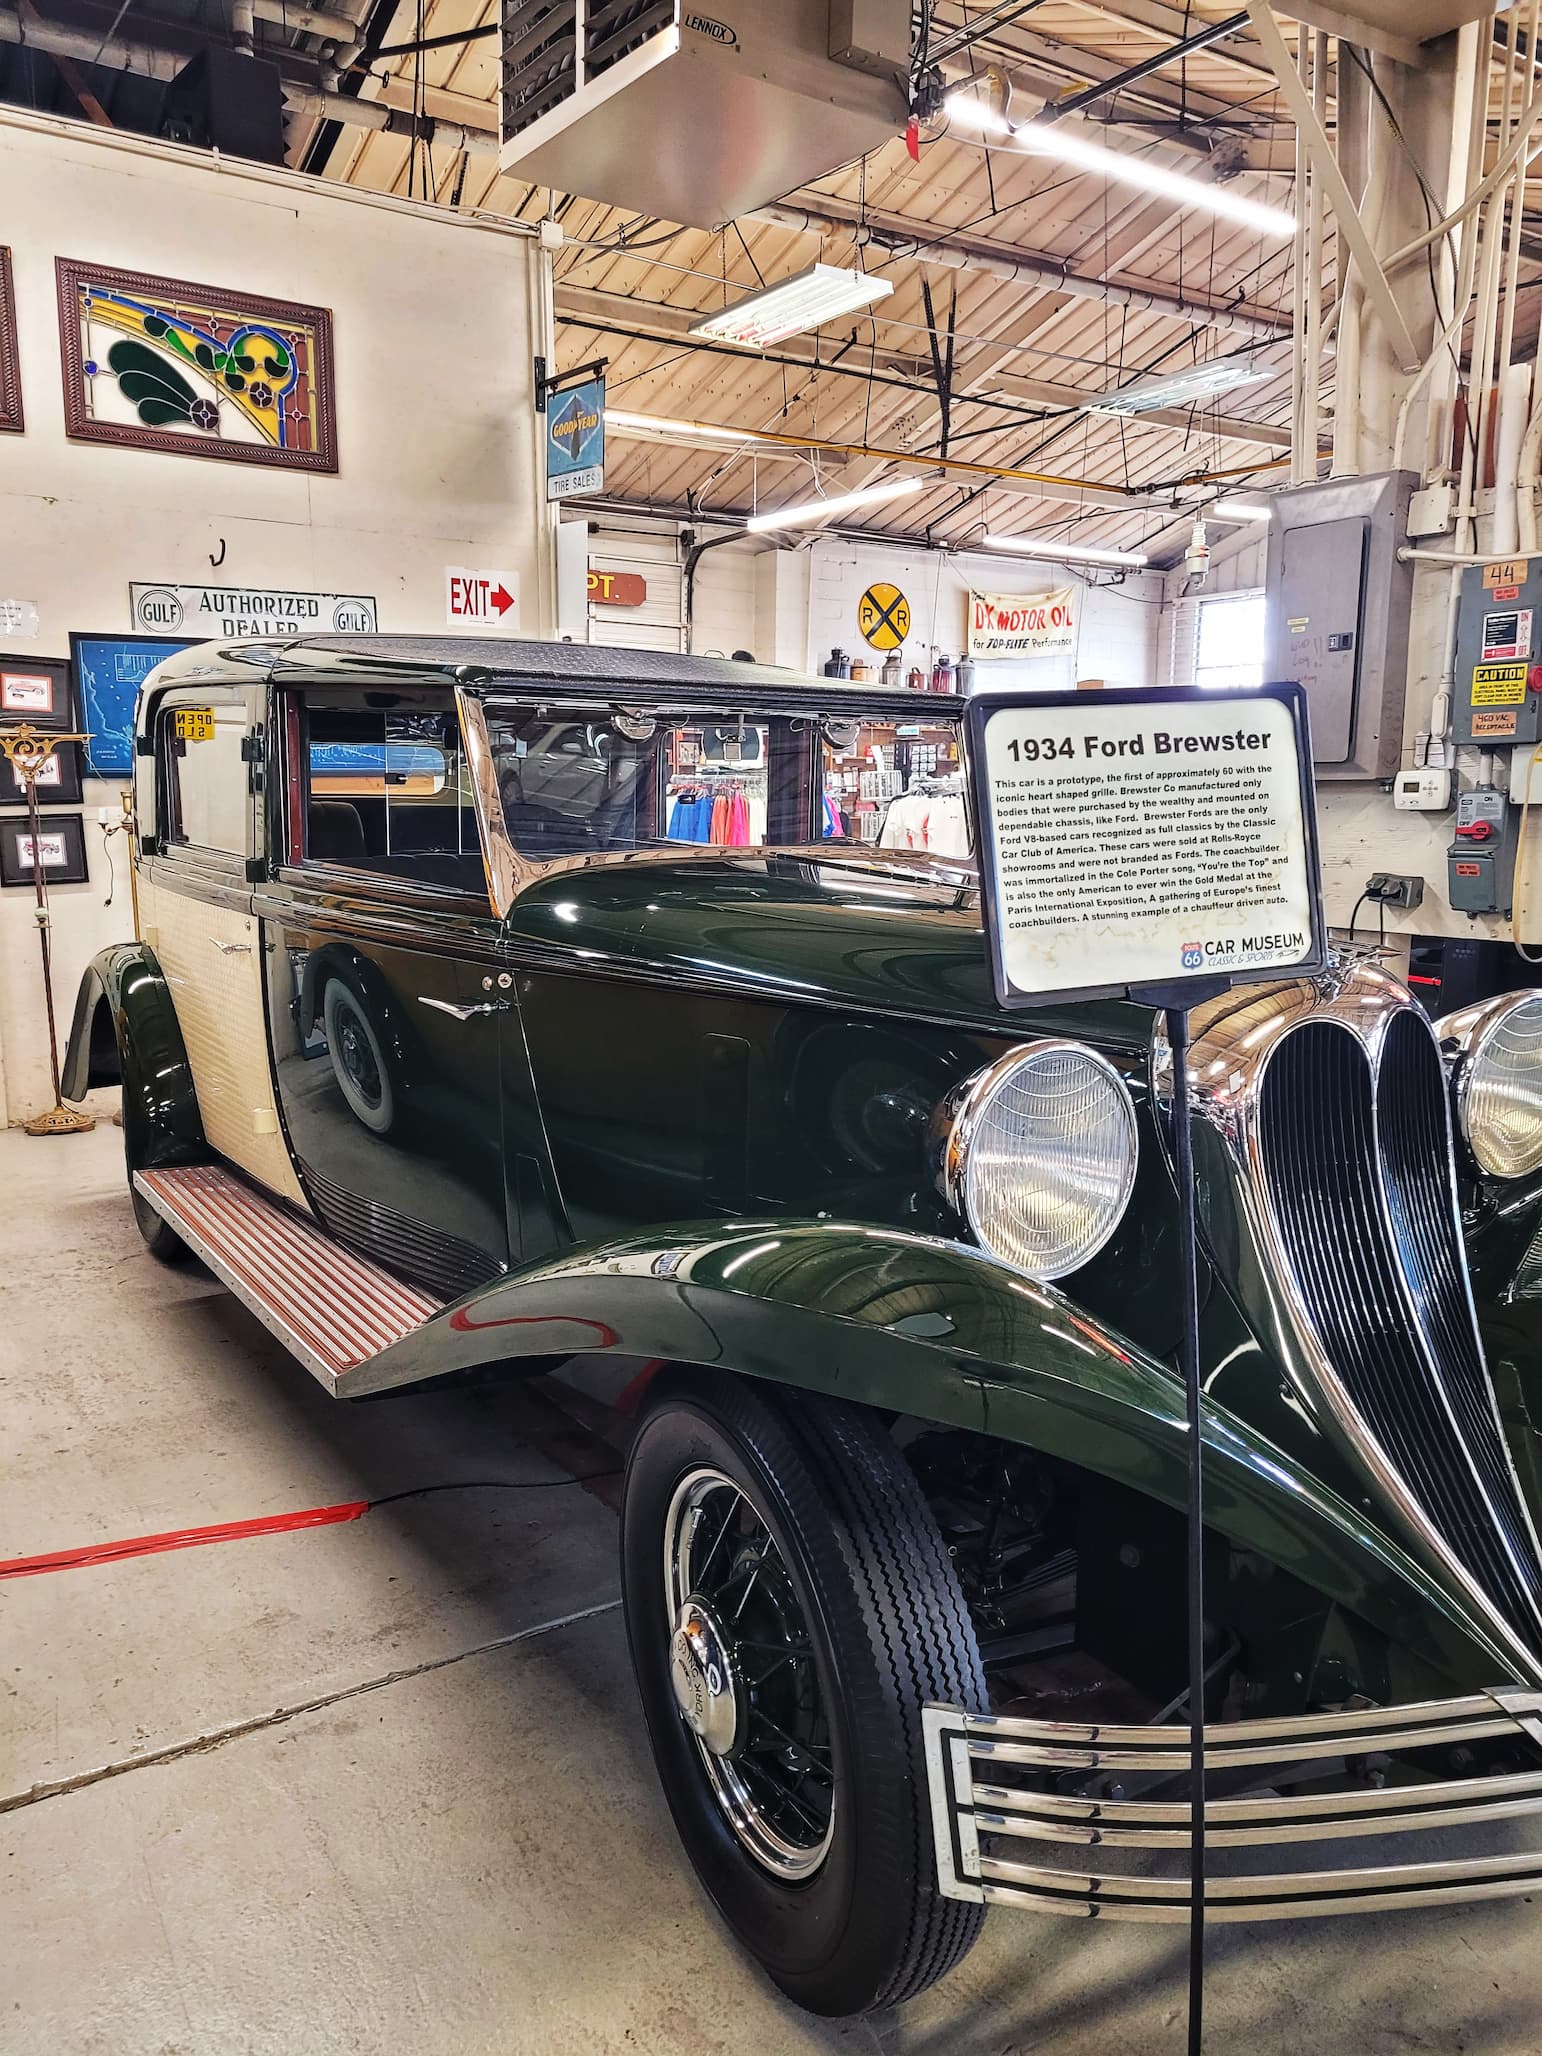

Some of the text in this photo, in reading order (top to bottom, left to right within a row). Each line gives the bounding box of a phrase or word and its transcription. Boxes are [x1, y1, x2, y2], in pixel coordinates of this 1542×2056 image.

[685, 14, 727, 40] LENNOX
[553, 472, 596, 494] TIRE SALES
[1490, 565, 1514, 584] 44
[199, 591, 320, 618] AUTHORIZED
[450, 577, 490, 616] EXIT
[142, 603, 178, 624] GULF
[337, 612, 368, 632] GULF
[862, 607, 908, 626] R R
[997, 608, 1046, 632] MOTOR
[1050, 605, 1073, 627] OIL
[973, 638, 984, 649] for
[1032, 637, 1073, 648] Performance
[1477, 669, 1524, 682] CAUTION
[1007, 729, 1272, 762] 1934 Ford Brewster
[994, 764, 1272, 789] This car is a prototype, the first of approximately 60 with the
[996, 778, 1262, 804] iconic heart shaped grille. Brewster Co manufactured only
[996, 791, 1270, 817] bodies that were purchased by the wealthy and mounted on
[998, 804, 1269, 833] dependable chassis, like Ford. Brewster Fords are the only
[999, 817, 1277, 846] Ford V8-based cars recognized as full classics by the Classic
[1001, 833, 1262, 860] Car Club of America. These cars were sold at Rolls-Royce
[1001, 844, 1281, 874] showrooms and were not branded as Fords. The coachbuilder
[1002, 879, 1024, 888] was
[1024, 872, 1086, 886] immortalized
[1087, 872, 1097, 881] in
[1098, 871, 1115, 880] the
[1116, 868, 1138, 879] Cole
[1139, 866, 1170, 877] Porter
[1171, 865, 1196, 874] song,
[1231, 859, 1247, 869] the
[1271, 855, 1289, 865] and
[1005, 871, 1274, 902] is also the only American to ever win the Gold Medal at the
[1007, 882, 1281, 916] Paris International Exposition, A gathering of Europe's finest
[1008, 915, 1080, 929] coachbuilders.
[1082, 913, 1090, 922] A
[1091, 910, 1129, 921] stunning
[1130, 906, 1171, 918] example
[1172, 904, 1181, 914] of
[1190, 901, 1235, 912] chauffeur
[1235, 897, 1264, 907] driven
[1205, 932, 1305, 956] CAR MUSEUM
[1184, 952, 1201, 966] 66
[1208, 951, 1275, 967] CLASSIC & SPORTS
